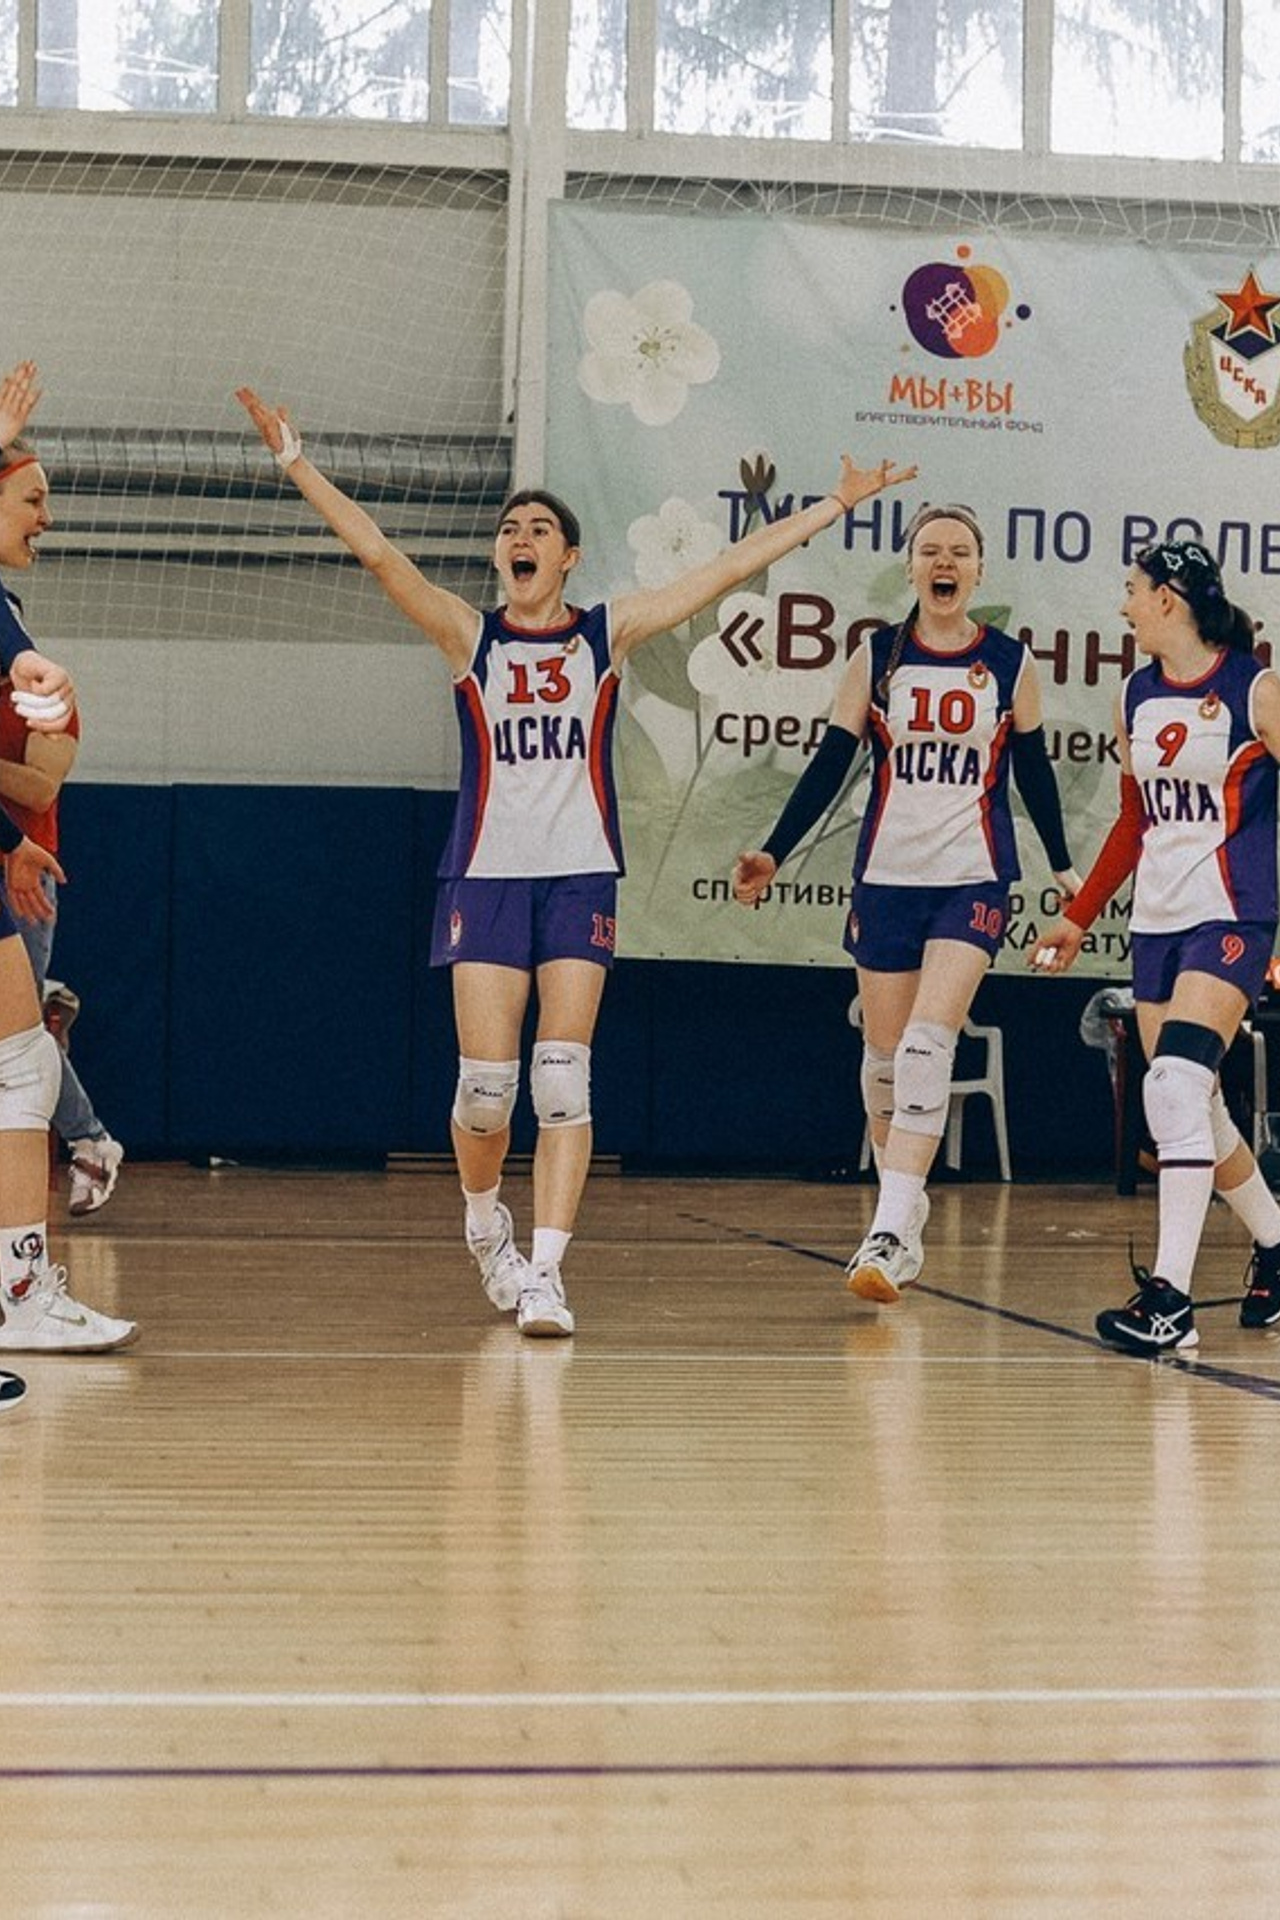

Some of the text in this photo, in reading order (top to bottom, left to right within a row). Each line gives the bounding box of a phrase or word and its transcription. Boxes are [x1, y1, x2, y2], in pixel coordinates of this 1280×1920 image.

[889, 373, 1013, 415] МЫ+ВЫ
[1219, 356, 1267, 404] ЦСКА
[1007, 507, 1091, 564] ПО
[507, 657, 571, 704] 13
[908, 687, 976, 735] 10
[494, 715, 586, 765] ЦСКА
[1155, 722, 1188, 767] 9
[895, 741, 980, 786] ЦСКА
[970, 902, 1002, 939] 10
[1221, 934, 1245, 965] 9
